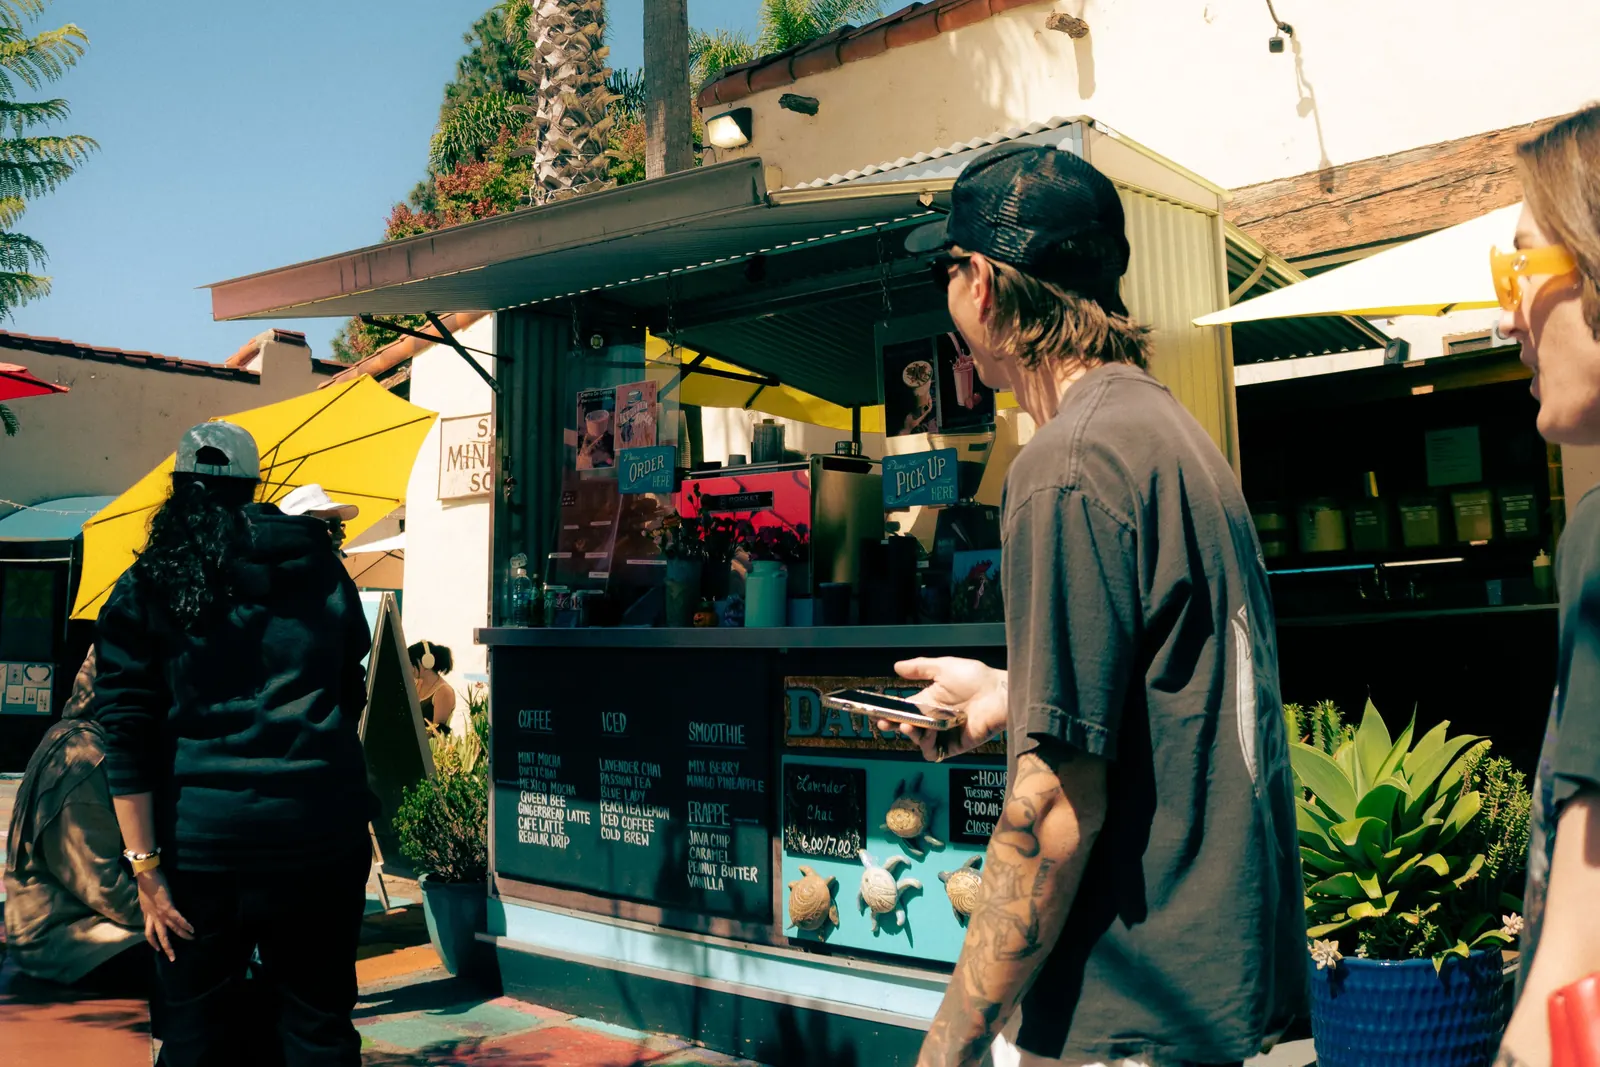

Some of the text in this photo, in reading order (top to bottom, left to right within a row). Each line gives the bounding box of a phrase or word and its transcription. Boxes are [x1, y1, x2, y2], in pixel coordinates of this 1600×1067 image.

[477, 418, 491, 438] S
[629, 454, 665, 483] ORDER
[896, 456, 946, 496] PICK UP
[652, 475, 671, 488] HERE
[931, 485, 955, 501] HERE
[518, 709, 553, 731] COFFEE
[601, 711, 627, 733] ICED
[688, 721, 746, 745] SMOOTHIE
[517, 751, 536, 765] MINT
[598, 756, 662, 779] LAVENDER CHAI
[688, 759, 741, 776] MIX BERRY
[519, 777, 577, 796] MEXICO MOCHA
[599, 772, 652, 789] PASSION TEA
[686, 774, 765, 793] MANGO PINEAPPLE
[796, 773, 847, 794] Lavender
[520, 790, 567, 808] QUEEN BEE
[600, 785, 646, 804] BLUE LADY
[517, 801, 591, 826] GINGERBREAD LATTE
[599, 798, 670, 821] PEACH TEA LEMON
[687, 800, 731, 826] FRAPPE
[806, 803, 836, 822] Chai
[517, 816, 565, 836] CAFE LATTE
[600, 812, 656, 833] ICED COFFEE
[518, 829, 571, 850] REGULAR DRIP
[600, 826, 650, 847] COLD BREW
[688, 829, 731, 849] JAVA CHIP
[688, 846, 732, 864] CARAMEL
[687, 859, 759, 884] PEANUT BUTTER
[686, 873, 725, 892] VANILLA
